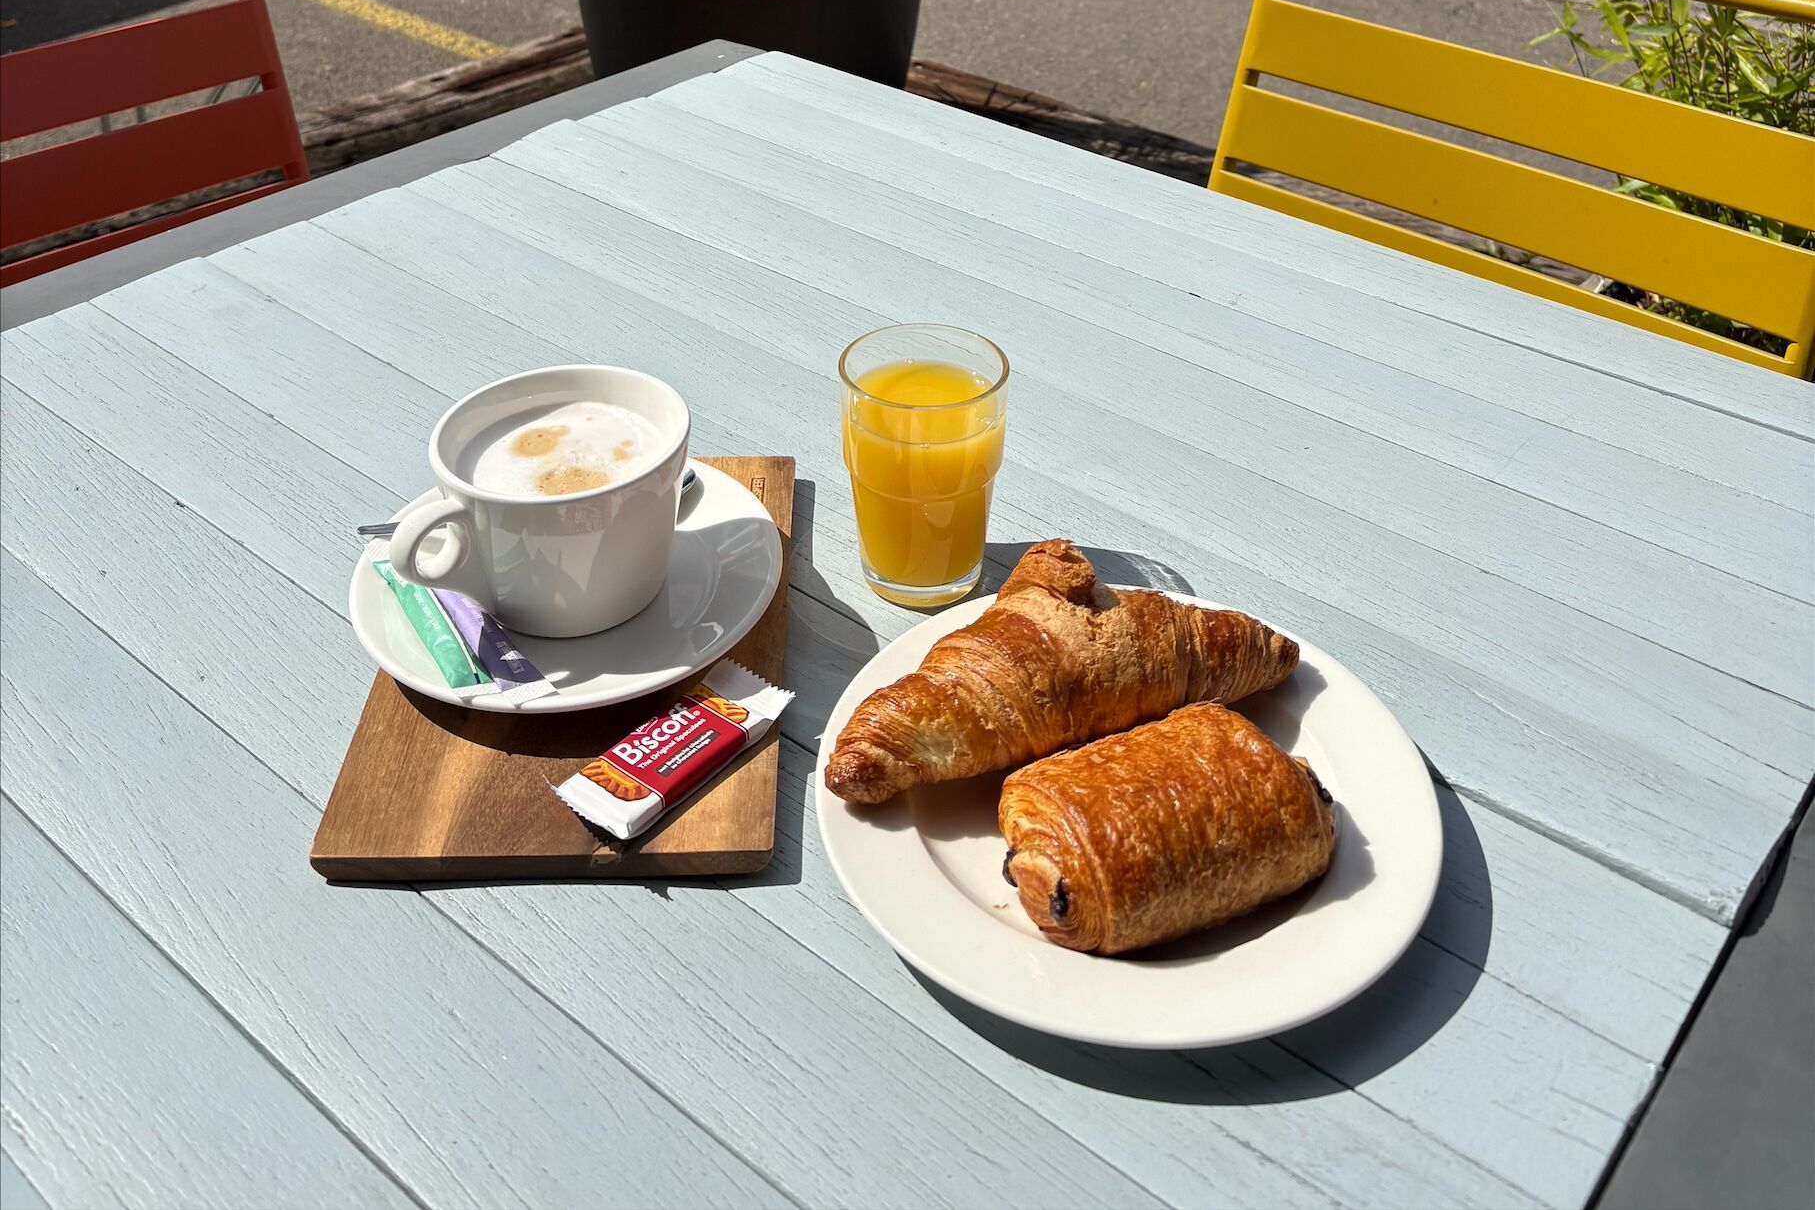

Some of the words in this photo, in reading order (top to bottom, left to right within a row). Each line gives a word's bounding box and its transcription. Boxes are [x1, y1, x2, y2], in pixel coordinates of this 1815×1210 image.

[612, 702, 696, 765] Biscoff
[637, 758, 653, 769] The
[650, 739, 676, 760] Original
[674, 718, 706, 742] Speculoos
